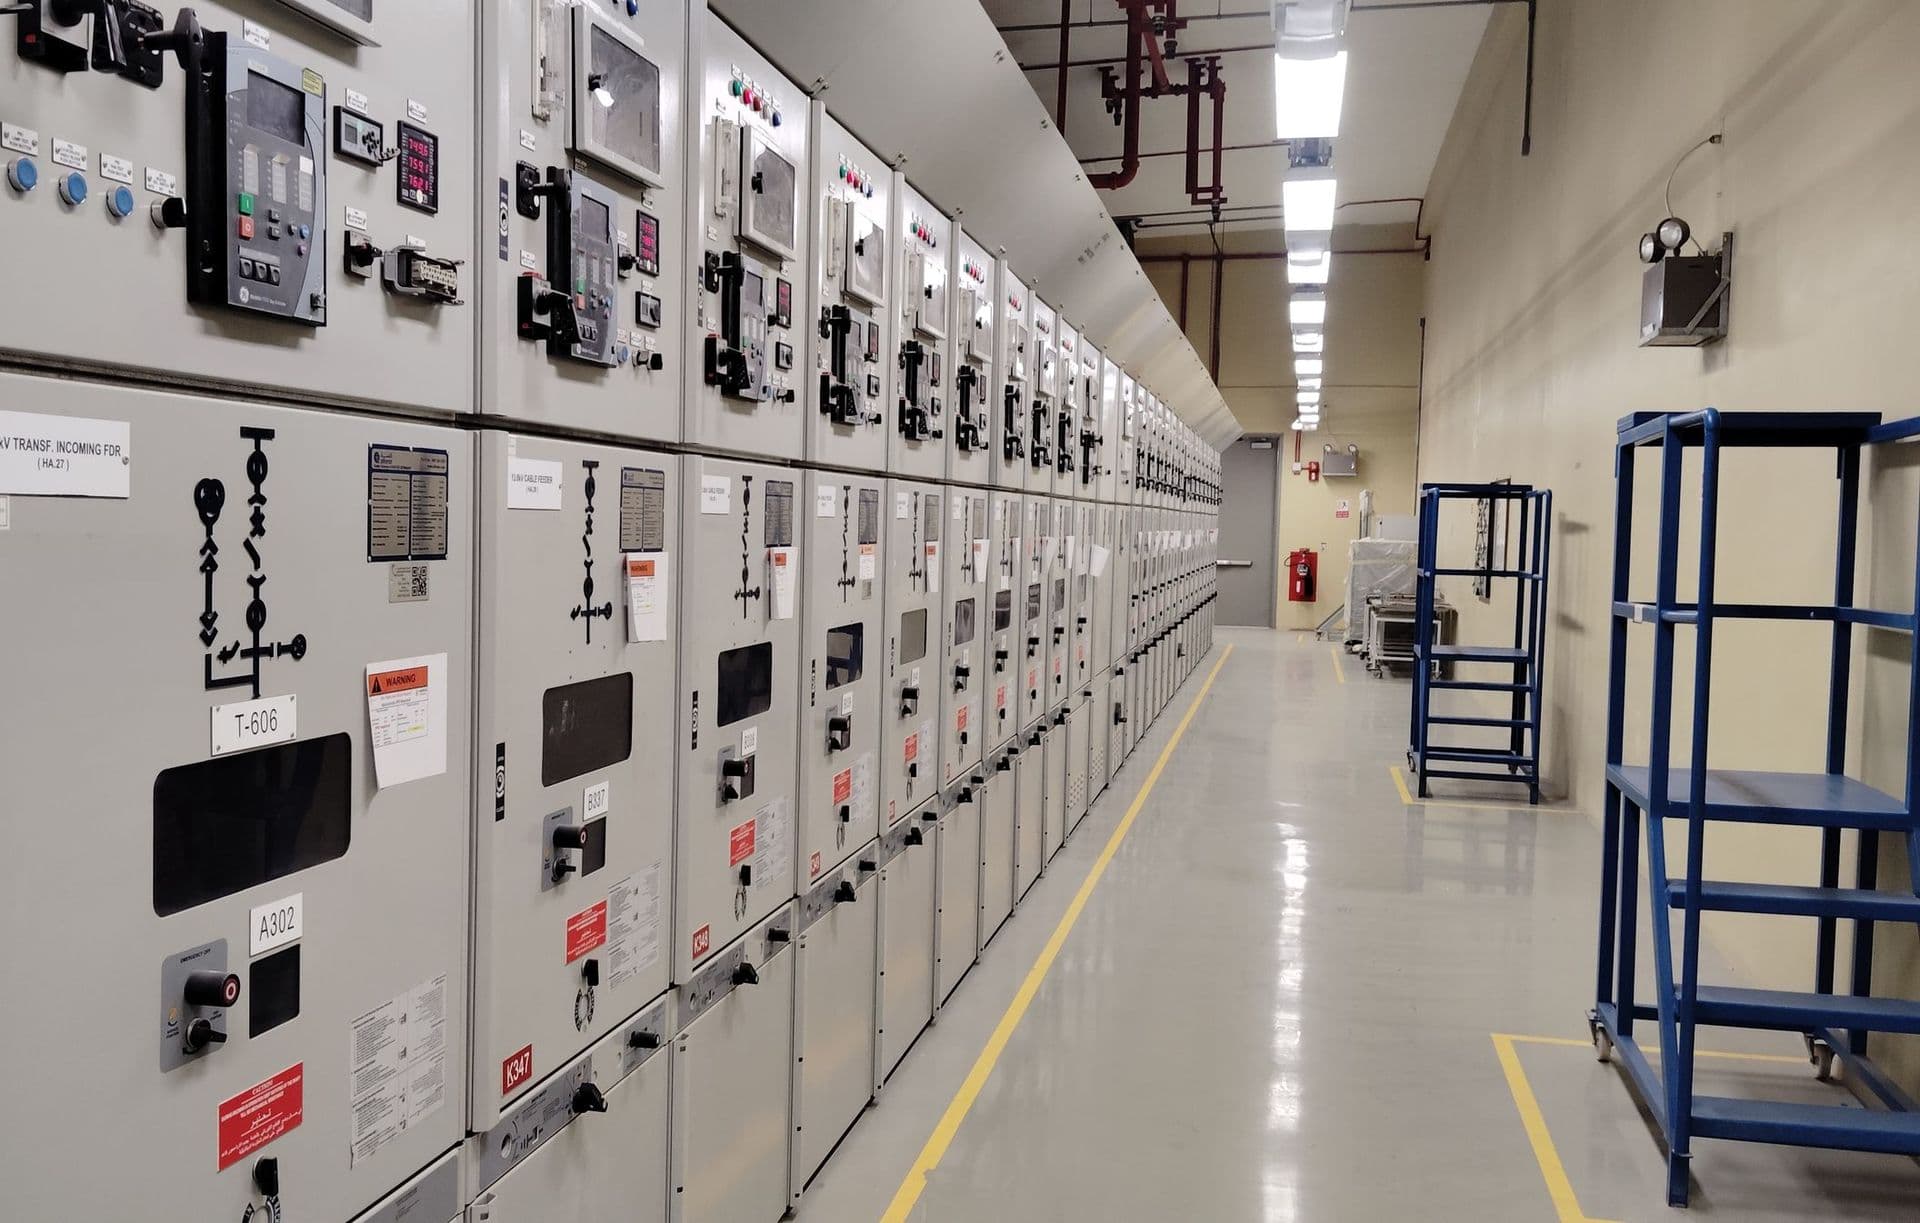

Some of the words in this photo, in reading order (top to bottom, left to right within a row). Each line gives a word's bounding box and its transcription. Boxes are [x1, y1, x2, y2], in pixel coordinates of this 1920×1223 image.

[13, 437, 55, 453] TRANSF.
[56, 440, 101, 456] INCOMING
[104, 443, 121, 457] FDR
[385, 673, 417, 687] WARNING
[234, 708, 278, 738] T-606
[259, 905, 295, 942] A302
[507, 1051, 530, 1088] K347
